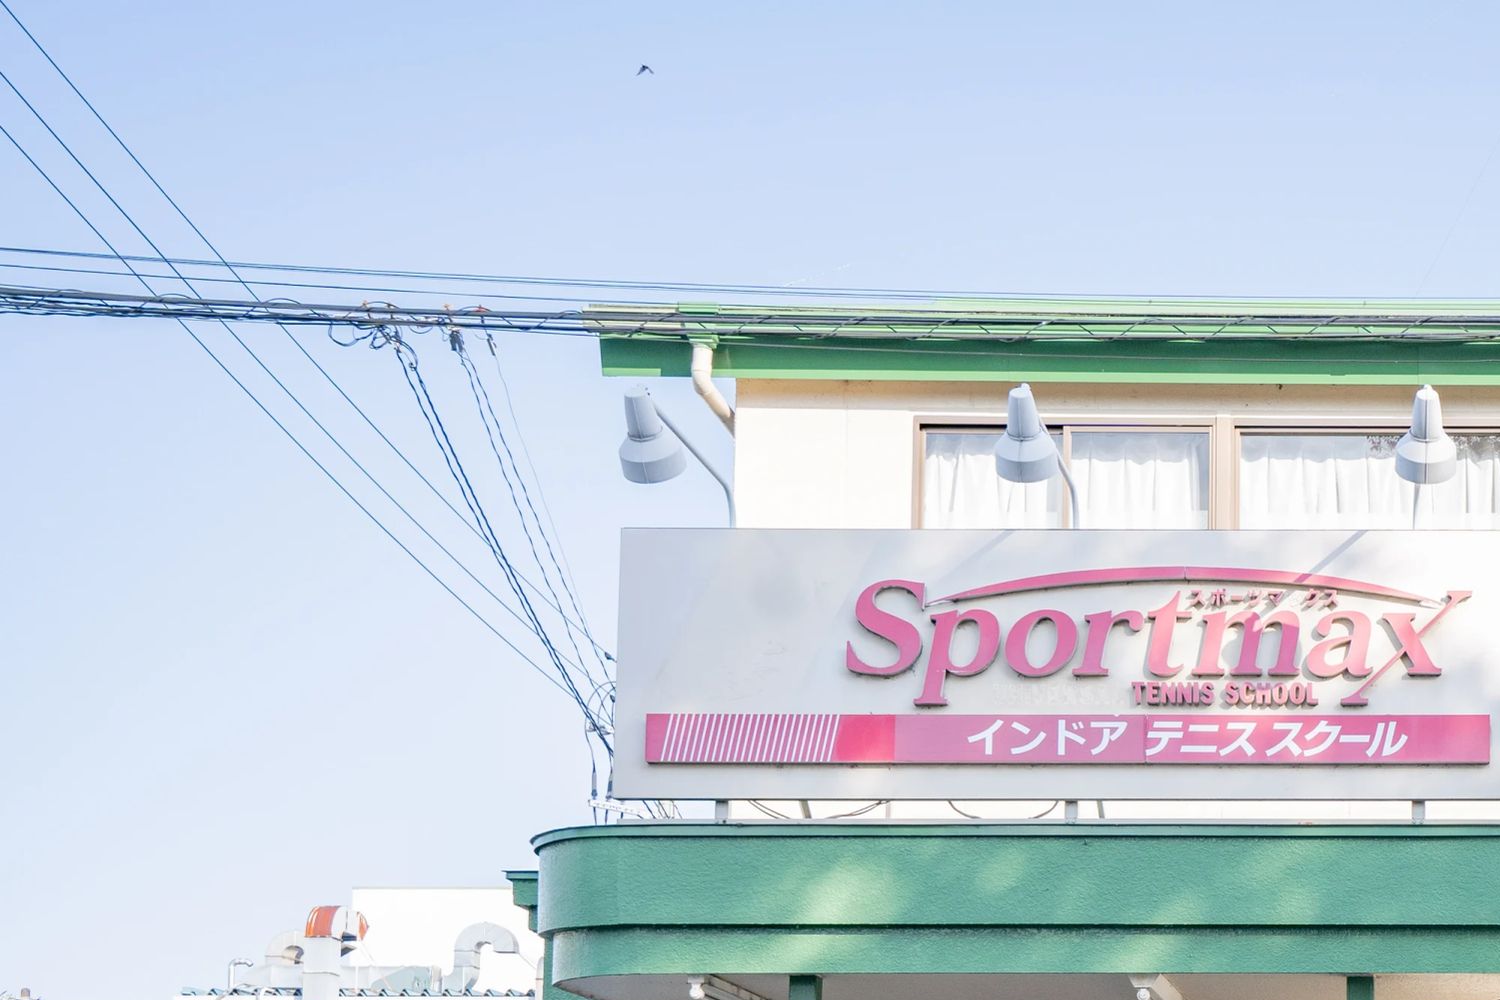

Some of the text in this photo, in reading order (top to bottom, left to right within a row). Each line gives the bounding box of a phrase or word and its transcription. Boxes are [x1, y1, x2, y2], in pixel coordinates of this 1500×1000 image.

[1187, 588, 1338, 609] スポーツマクス
[846, 576, 1471, 706] Sportmax
[1131, 681, 1214, 706] TENNIS
[1225, 681, 1319, 706] SCHOOL
[966, 721, 1408, 757] インドア テニス スクール
